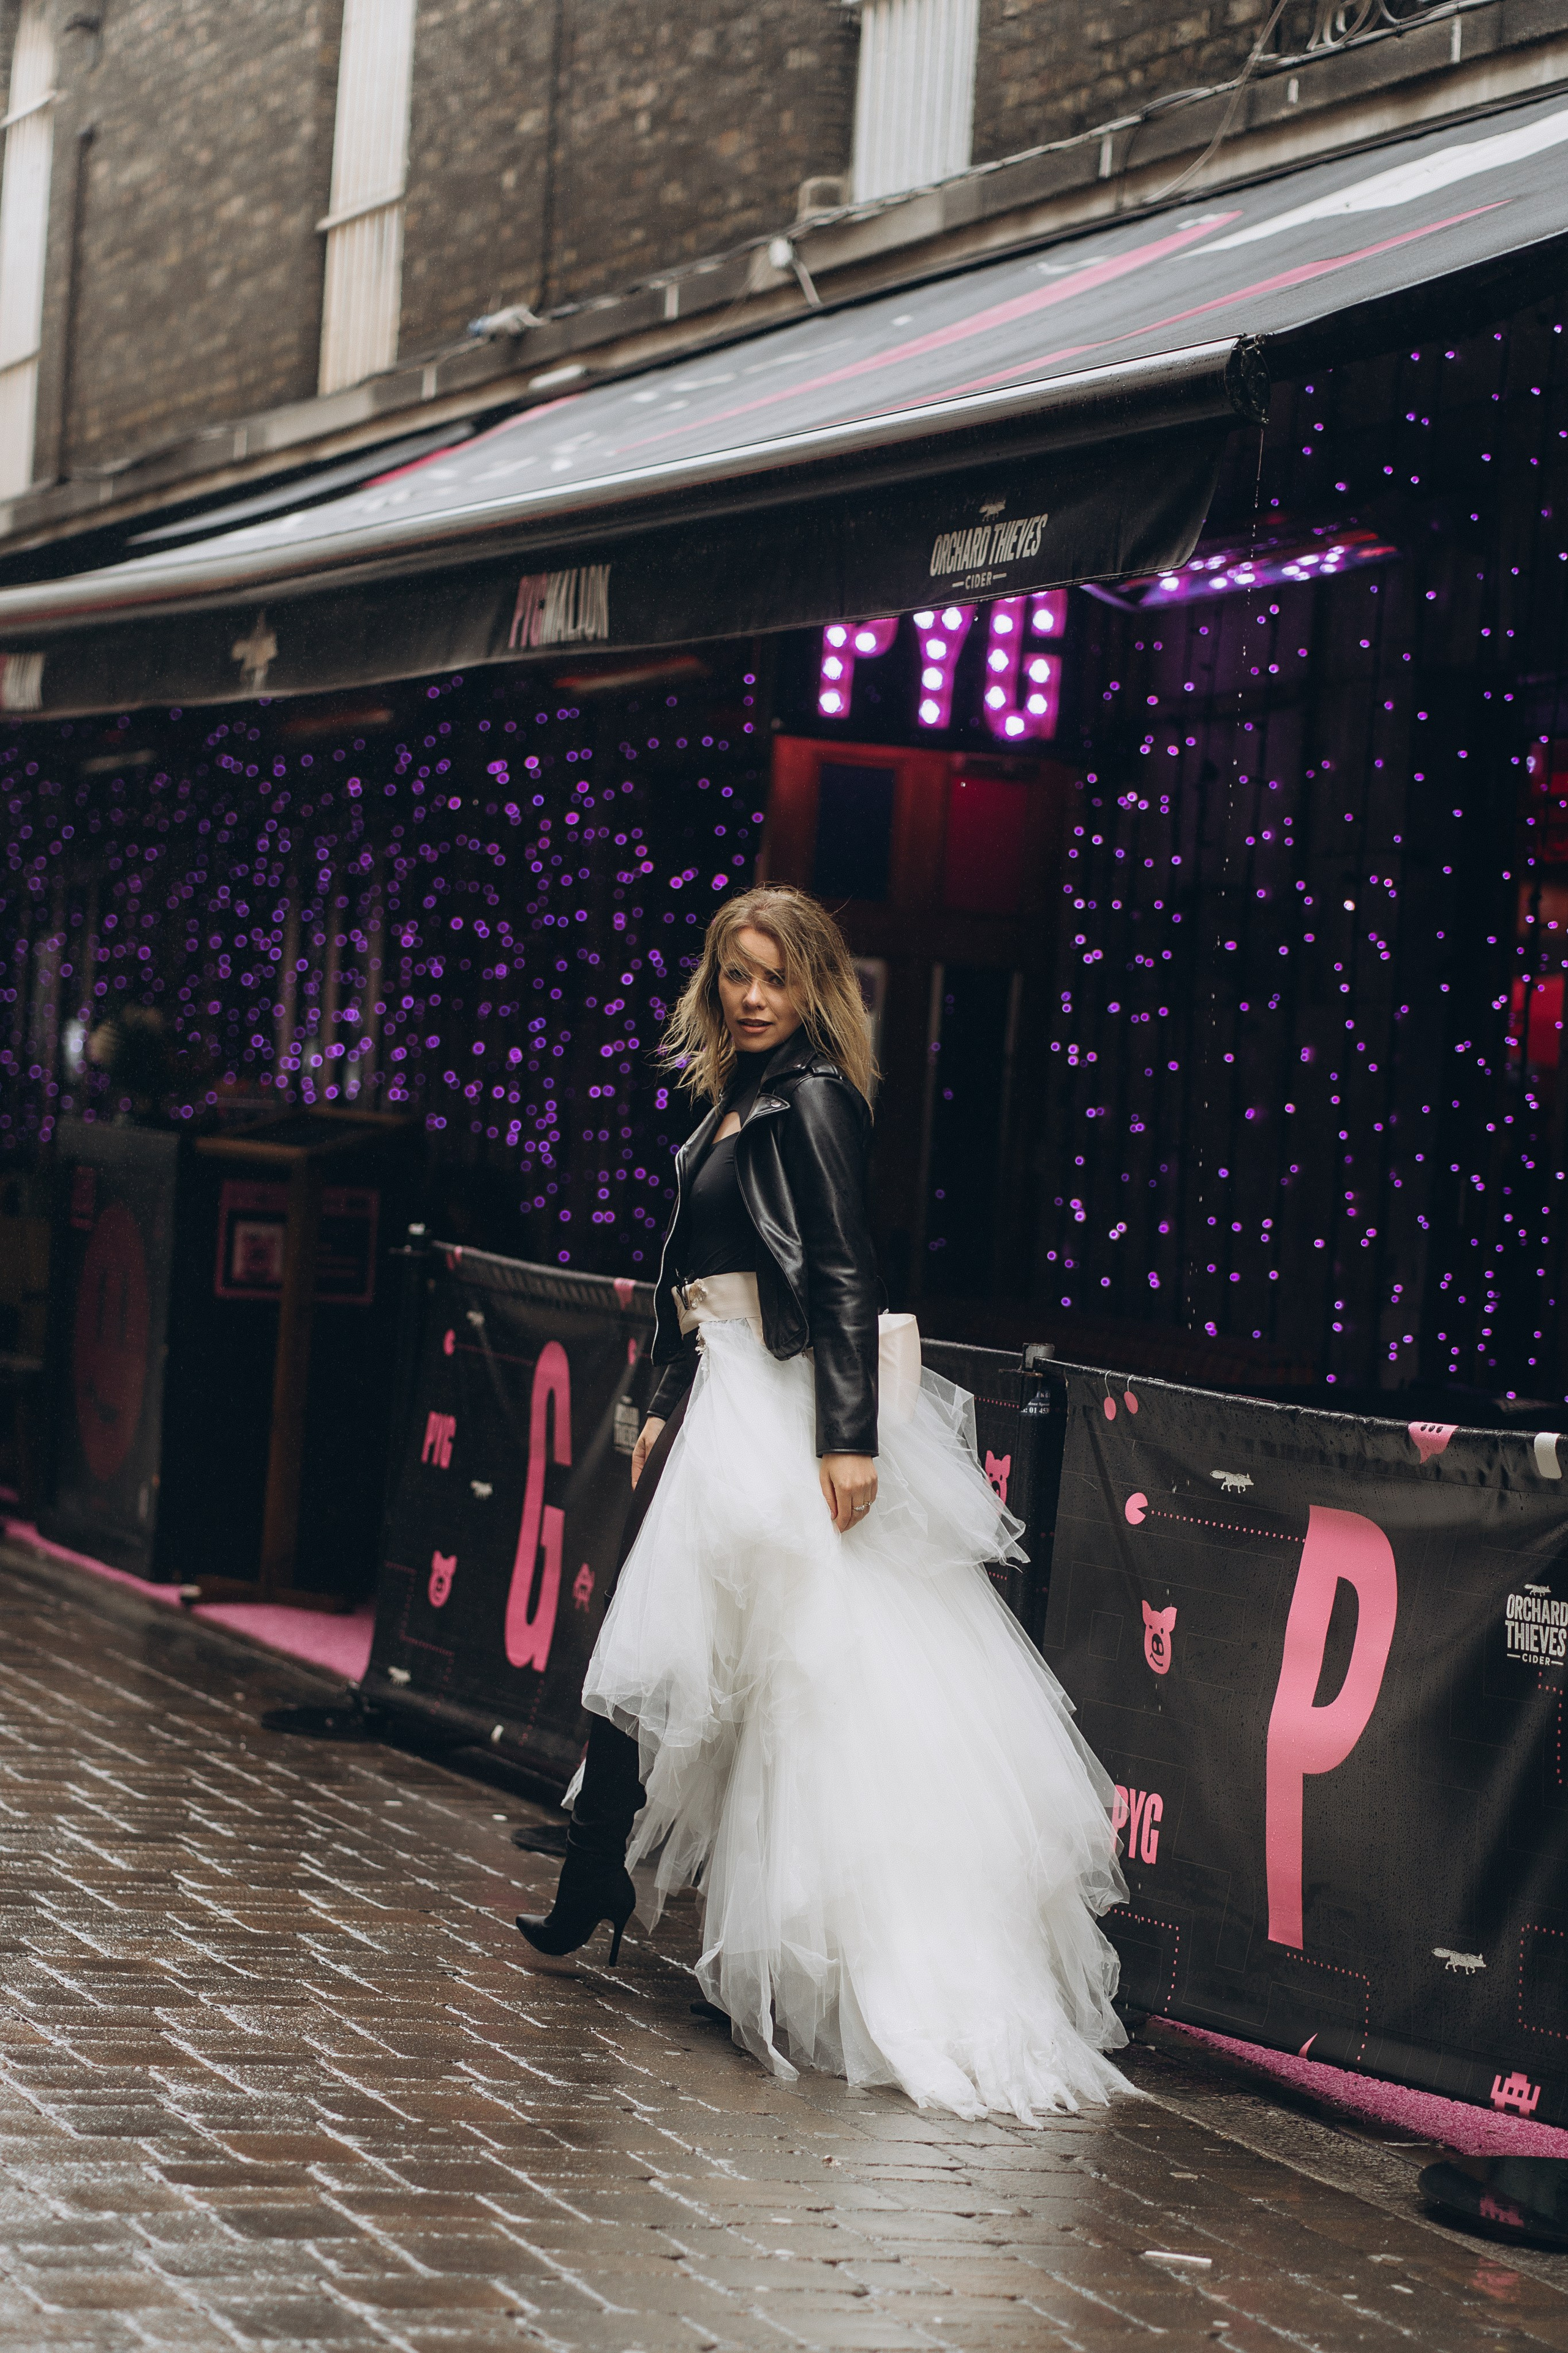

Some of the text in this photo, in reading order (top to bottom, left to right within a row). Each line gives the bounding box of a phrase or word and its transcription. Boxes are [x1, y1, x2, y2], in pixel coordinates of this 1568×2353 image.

[929, 513, 1049, 576] ORCHARD THIEVES
[965, 572, 992, 590] CIDER
[818, 589, 1068, 741] PYG
[421, 1410, 456, 1469] PYG
[505, 1340, 572, 1673] G
[1505, 1620, 1567, 1657] THIEVES
[1506, 1593, 1568, 1626] ORCHARD
[1522, 1653, 1551, 1666] CIDER
[1265, 1505, 1398, 1950] P
[1111, 1784, 1164, 1865] PYG
